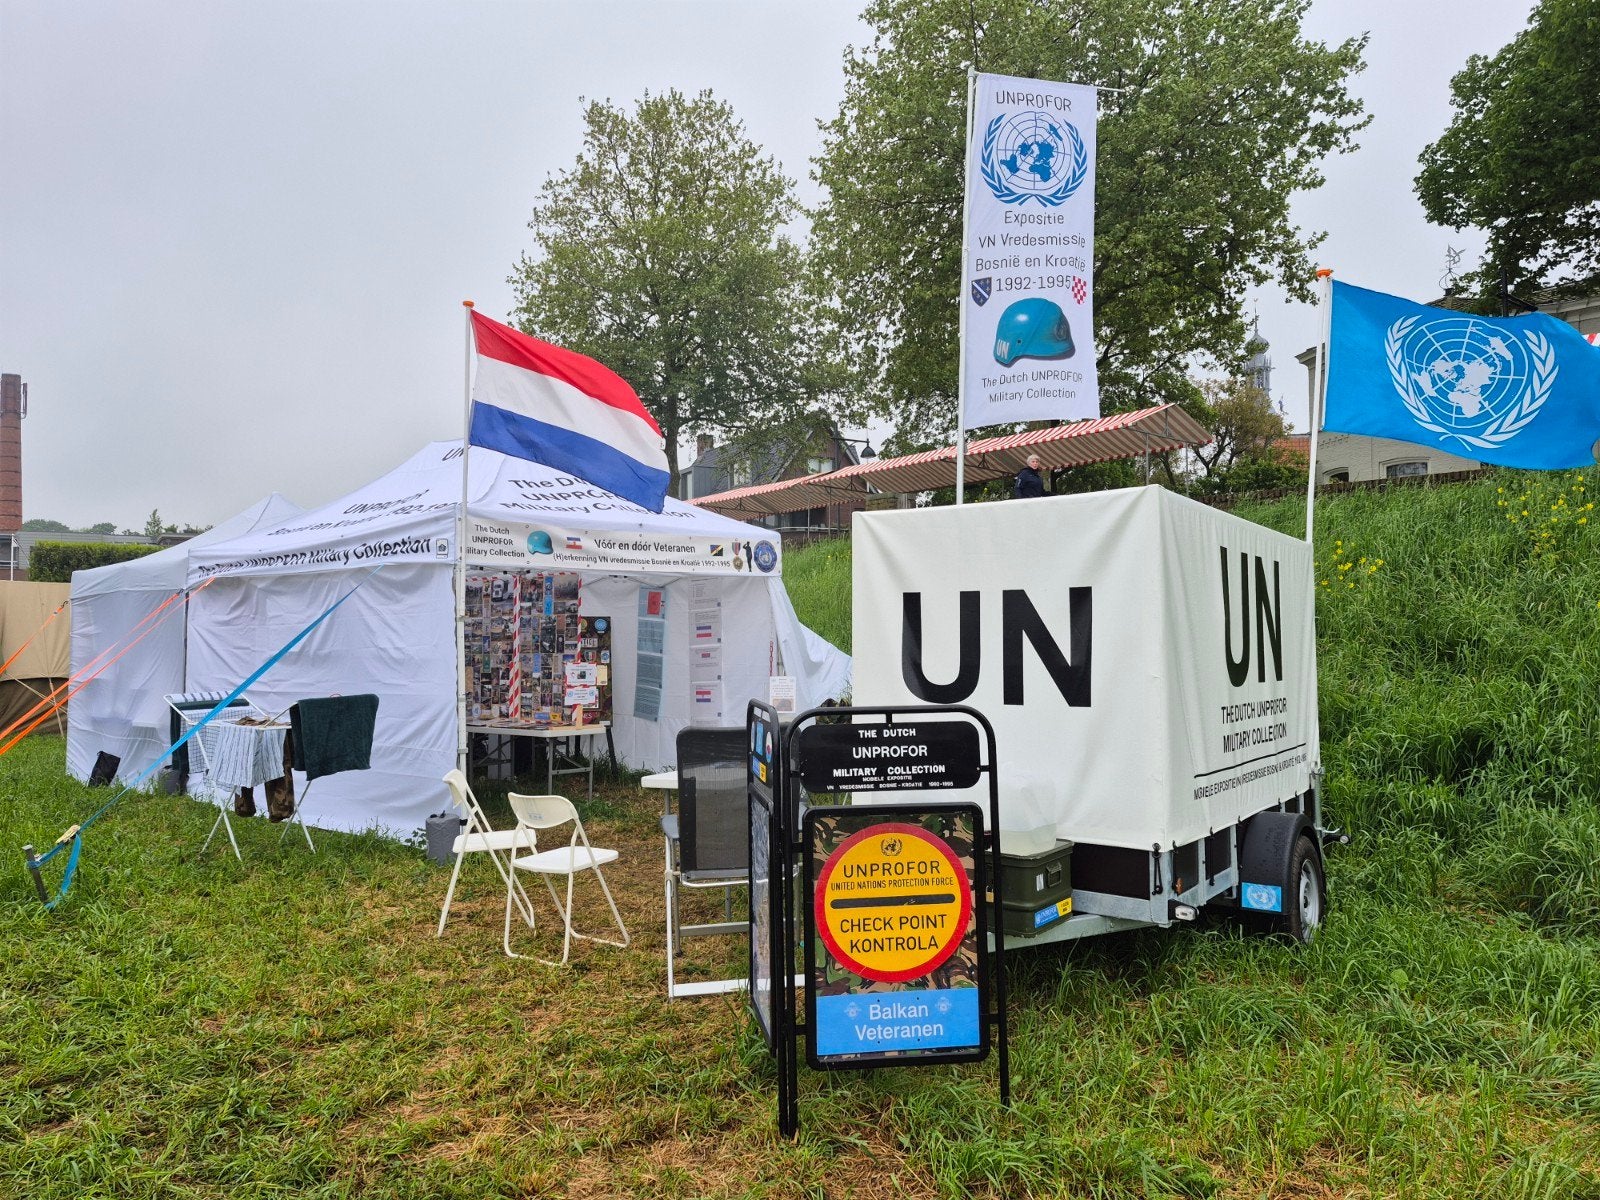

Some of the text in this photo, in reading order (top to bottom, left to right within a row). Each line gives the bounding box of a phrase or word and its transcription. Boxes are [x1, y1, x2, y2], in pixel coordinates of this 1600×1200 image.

[996, 90, 1072, 112] UNPROFOR
[1004, 210, 1065, 227] Expositie
[978, 232, 1086, 248] VN Vredesmissie
[975, 254, 1086, 272] Bosnië en Kroatië
[995, 275, 1072, 292] 1992-1995
[996, 339, 1011, 359] UN
[982, 369, 1083, 389] The Dutch UNPROFOR
[989, 387, 1076, 404] Military Collection
[508, 479, 554, 489] The
[475, 524, 509, 535] The Dutch
[353, 536, 431, 559] Collection
[471, 535, 513, 546] UNPROFOR
[618, 542, 630, 551] en
[653, 542, 696, 554] Veteranen
[490, 548, 525, 558] Collection
[598, 555, 609, 564] VN
[1220, 546, 1283, 687] UN
[902, 586, 1092, 707] UN
[1221, 706, 1234, 724] THE
[858, 728, 916, 739] THE DUTCH
[852, 745, 928, 759] UNPROFOR
[833, 765, 946, 778] MILITARY COLLECTION
[843, 860, 941, 878] UNPROFOR
[831, 876, 954, 891] UNITED NATIONS PROTECTION FORCE
[840, 914, 947, 933] CHECK POINT
[850, 935, 939, 954] KONTROLA
[869, 1003, 929, 1021] Balkan
[855, 1022, 944, 1041] Veteranen
